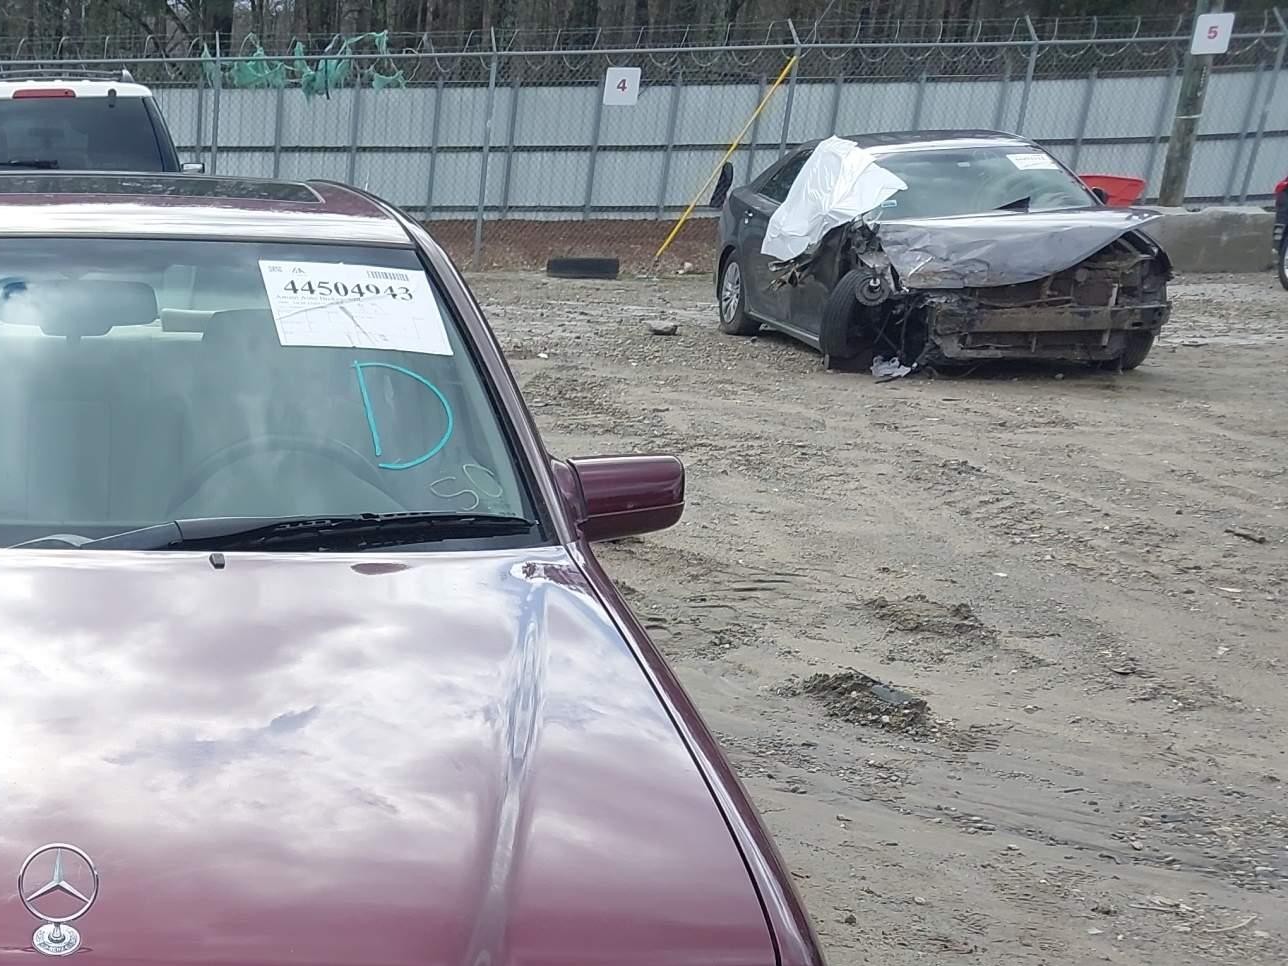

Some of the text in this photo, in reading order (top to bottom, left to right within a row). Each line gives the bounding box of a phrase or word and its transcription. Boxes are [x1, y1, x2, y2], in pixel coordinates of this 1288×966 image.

[1207, 25, 1218, 40] 5
[616, 78, 628, 92] 4
[283, 279, 414, 301] 44504943
[351, 360, 454, 470] D
